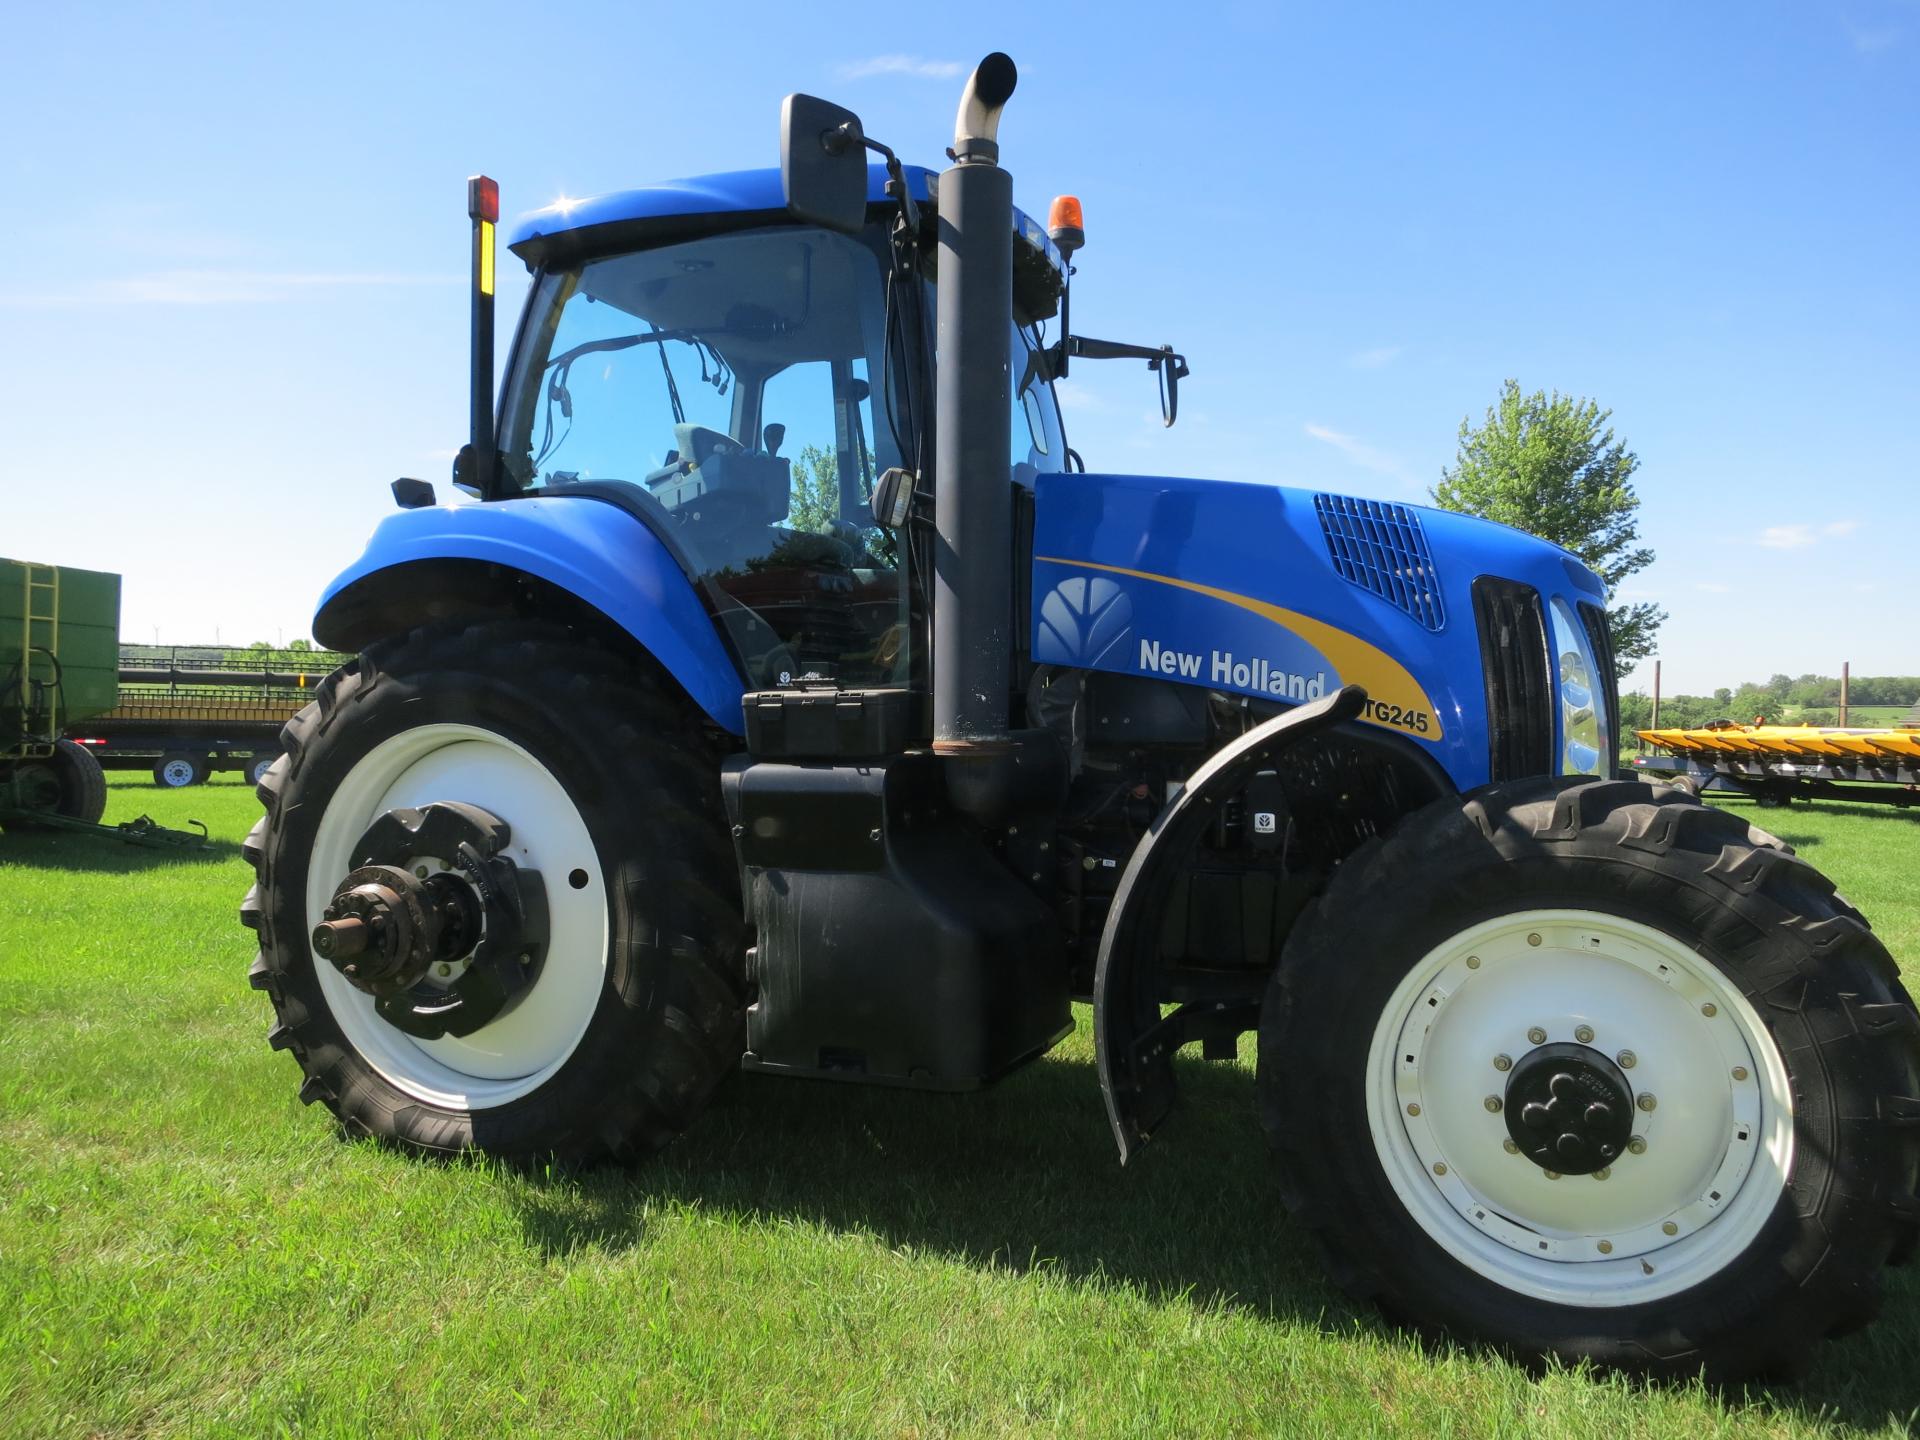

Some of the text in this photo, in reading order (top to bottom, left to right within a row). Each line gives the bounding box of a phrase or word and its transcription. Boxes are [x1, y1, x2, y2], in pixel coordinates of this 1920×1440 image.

[1140, 639, 1325, 702] New Holland
[1365, 700, 1428, 732] TG245
